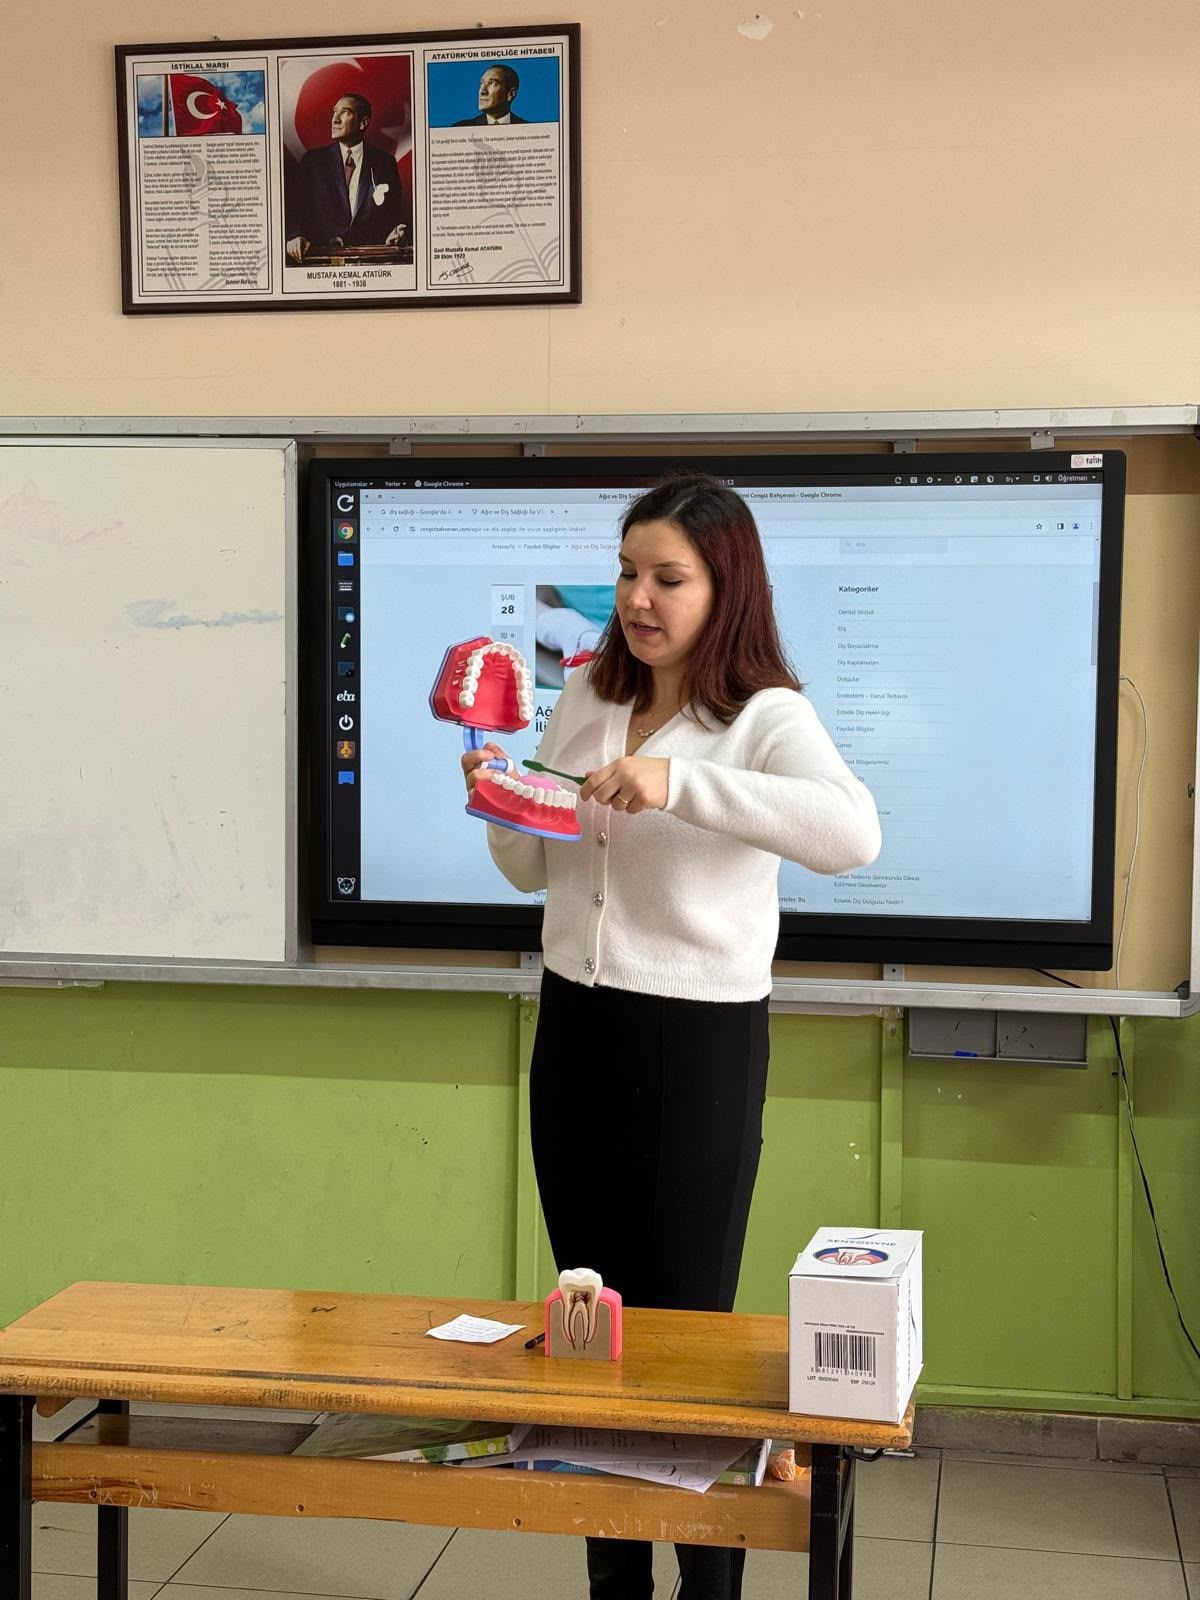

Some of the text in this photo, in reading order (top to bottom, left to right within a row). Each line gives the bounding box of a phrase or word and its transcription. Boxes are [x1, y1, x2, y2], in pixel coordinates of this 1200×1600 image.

[431, 46, 555, 60] ATATÜRK'ÜN GENÇLİĞE HİTABESİ
[171, 61, 229, 70] İSTİKLAL MARŞI
[306, 269, 393, 280] MUSTAFA KEMAL ATATÜRK
[332, 280, 347, 288] 1881
[352, 280, 367, 288] 1938
[1057, 474, 1088, 482] Öğretmen
[838, 585, 879, 593] Kategoriler
[500, 593, 515, 601] ŞUB
[501, 604, 515, 614] 28
